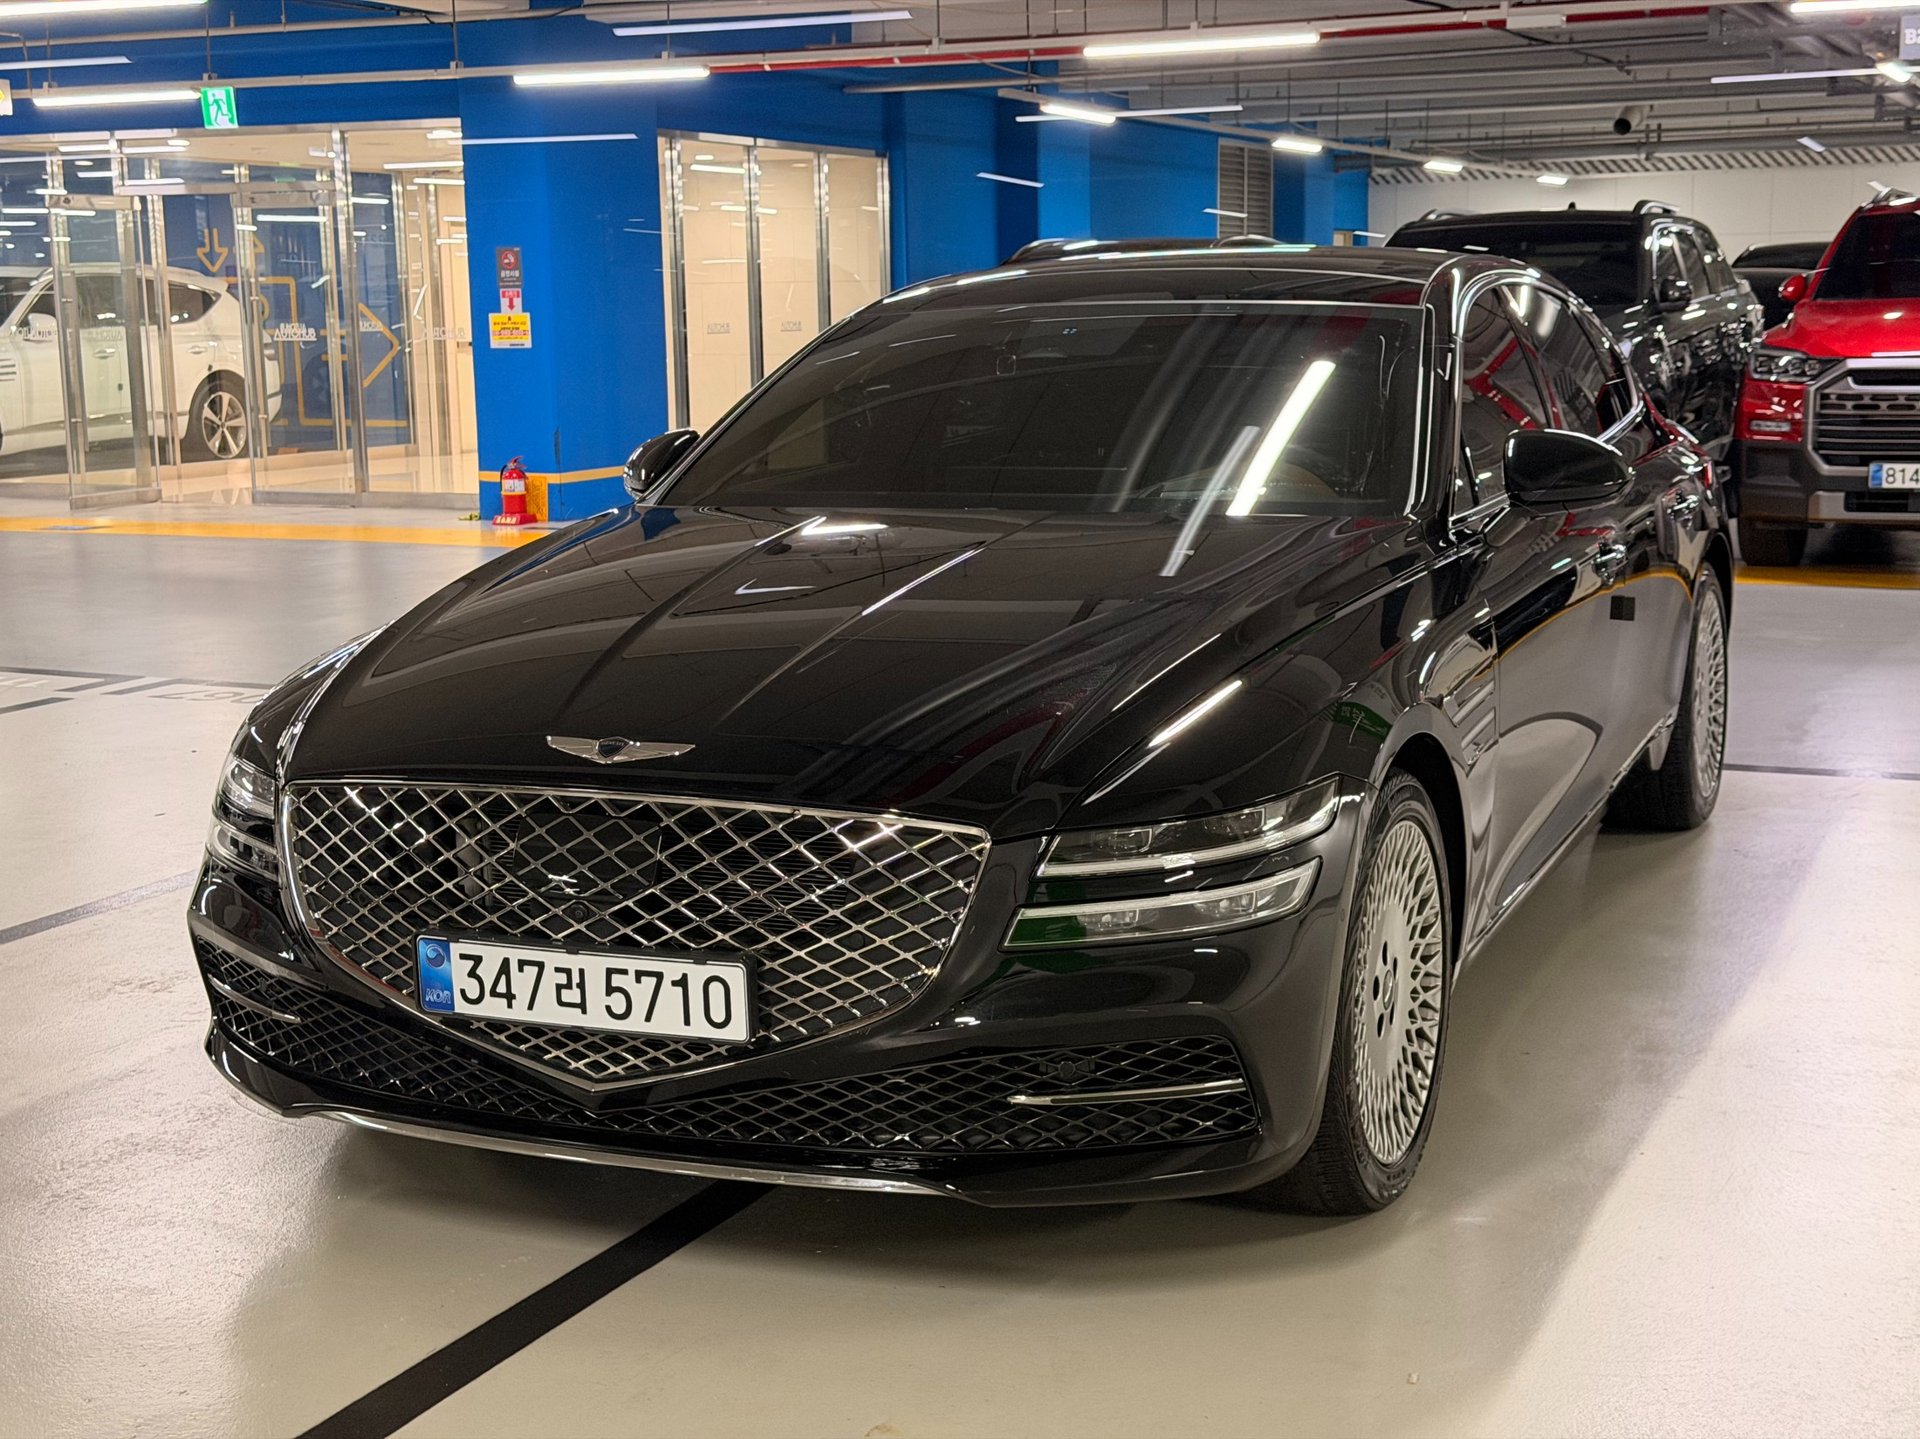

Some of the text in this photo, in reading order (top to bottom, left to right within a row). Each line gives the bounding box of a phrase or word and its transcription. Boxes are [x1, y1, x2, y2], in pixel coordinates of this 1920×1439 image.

[425, 987, 452, 1005] KOR
[458, 953, 733, 1030] 347러 5710
